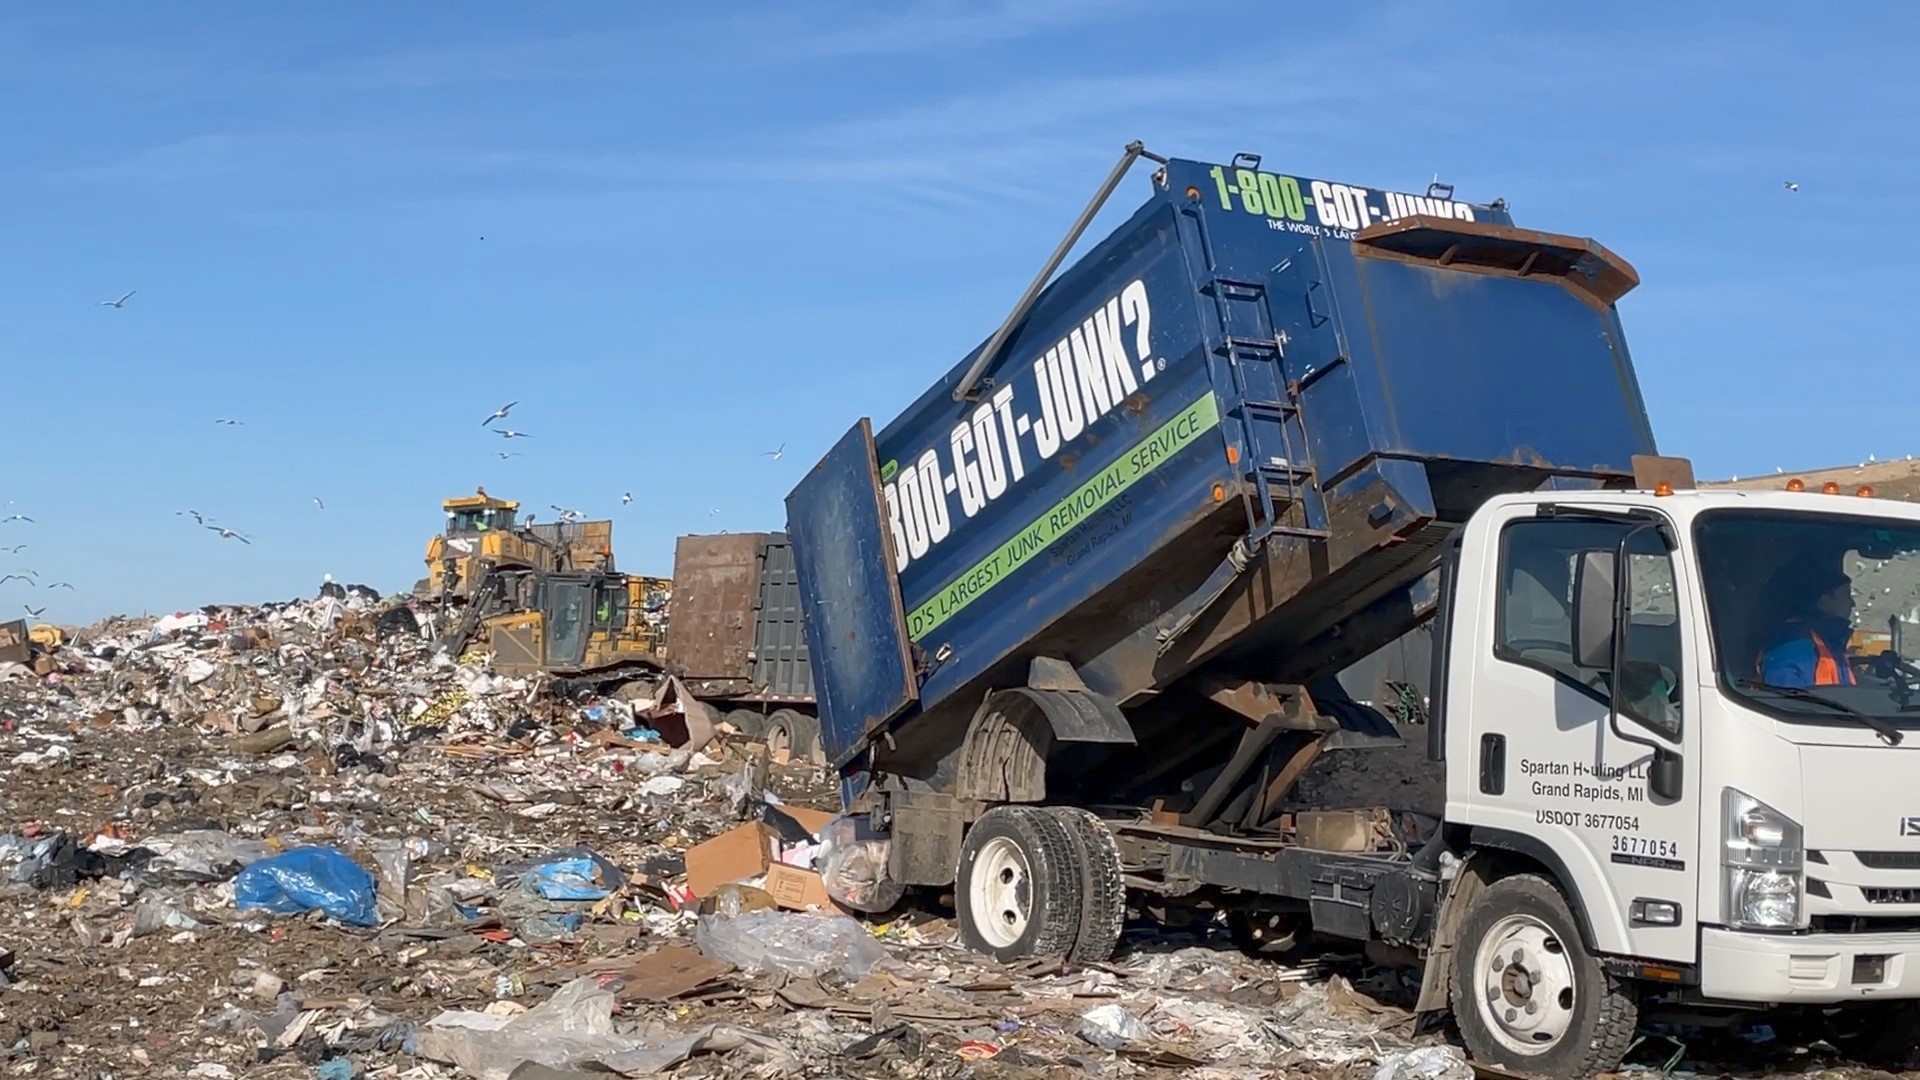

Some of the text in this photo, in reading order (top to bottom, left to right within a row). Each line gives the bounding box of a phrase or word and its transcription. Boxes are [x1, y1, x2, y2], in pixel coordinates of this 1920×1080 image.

[1266, 219, 1286, 231] THE
[939, 556, 1001, 617] LARGEST
[1007, 525, 1044, 568] JUNK
[1049, 468, 1126, 535] REMOVAL
[1130, 411, 1200, 475] SERVICE
[1520, 758, 1570, 777] Spartan
[1573, 761, 1625, 782] Huling
[1531, 780, 1644, 803] Grand Rapids, MI
[1535, 809, 1640, 831] USDOT 3677054
[1612, 835, 1677, 858] 3677054
